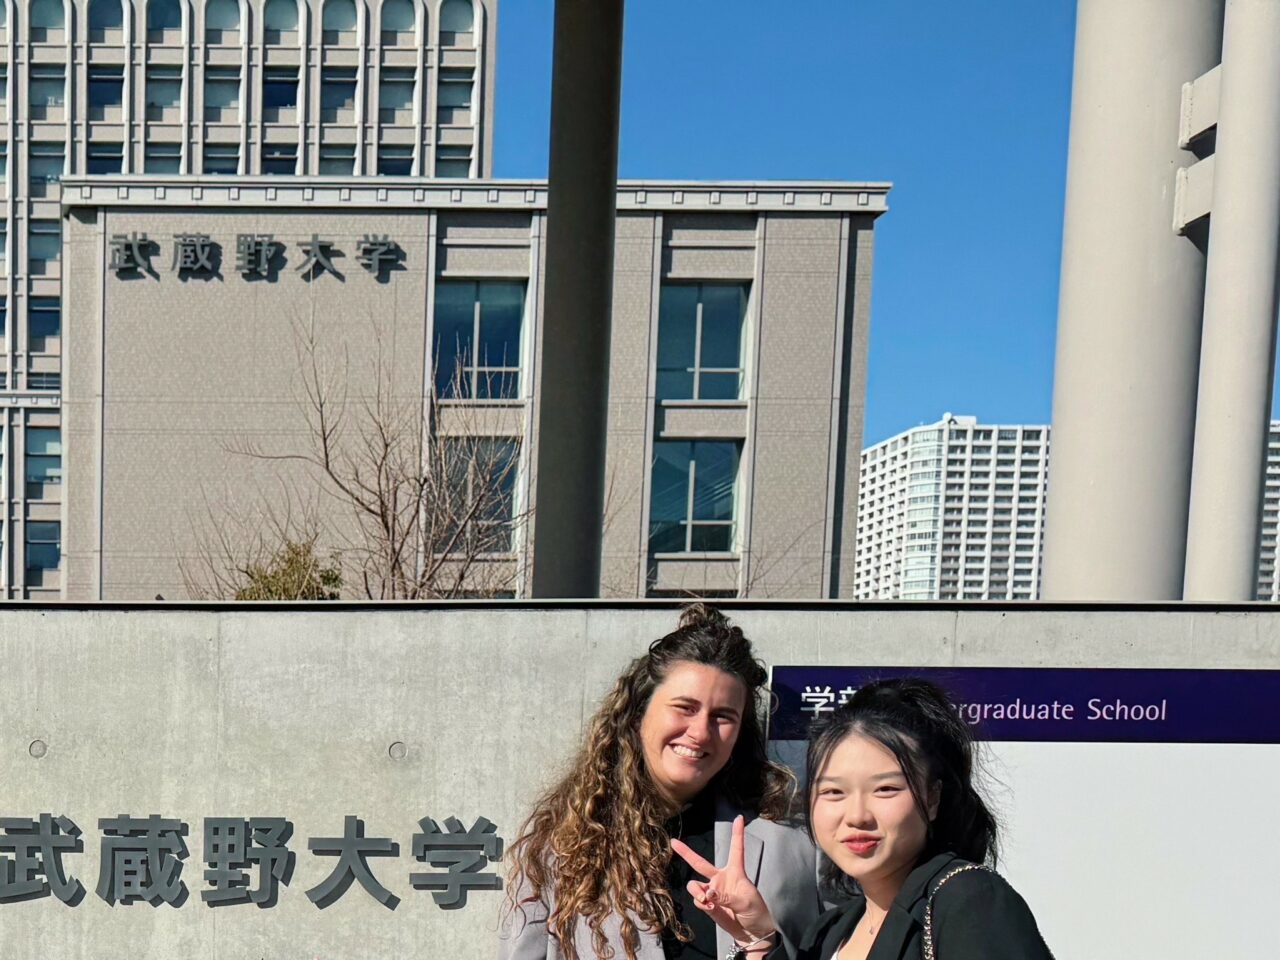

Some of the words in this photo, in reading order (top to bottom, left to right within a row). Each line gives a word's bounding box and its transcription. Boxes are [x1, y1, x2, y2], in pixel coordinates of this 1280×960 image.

[109, 232, 396, 273] 武蔵野大学
[951, 698, 1074, 724] rgraduate
[1087, 699, 1167, 722] School
